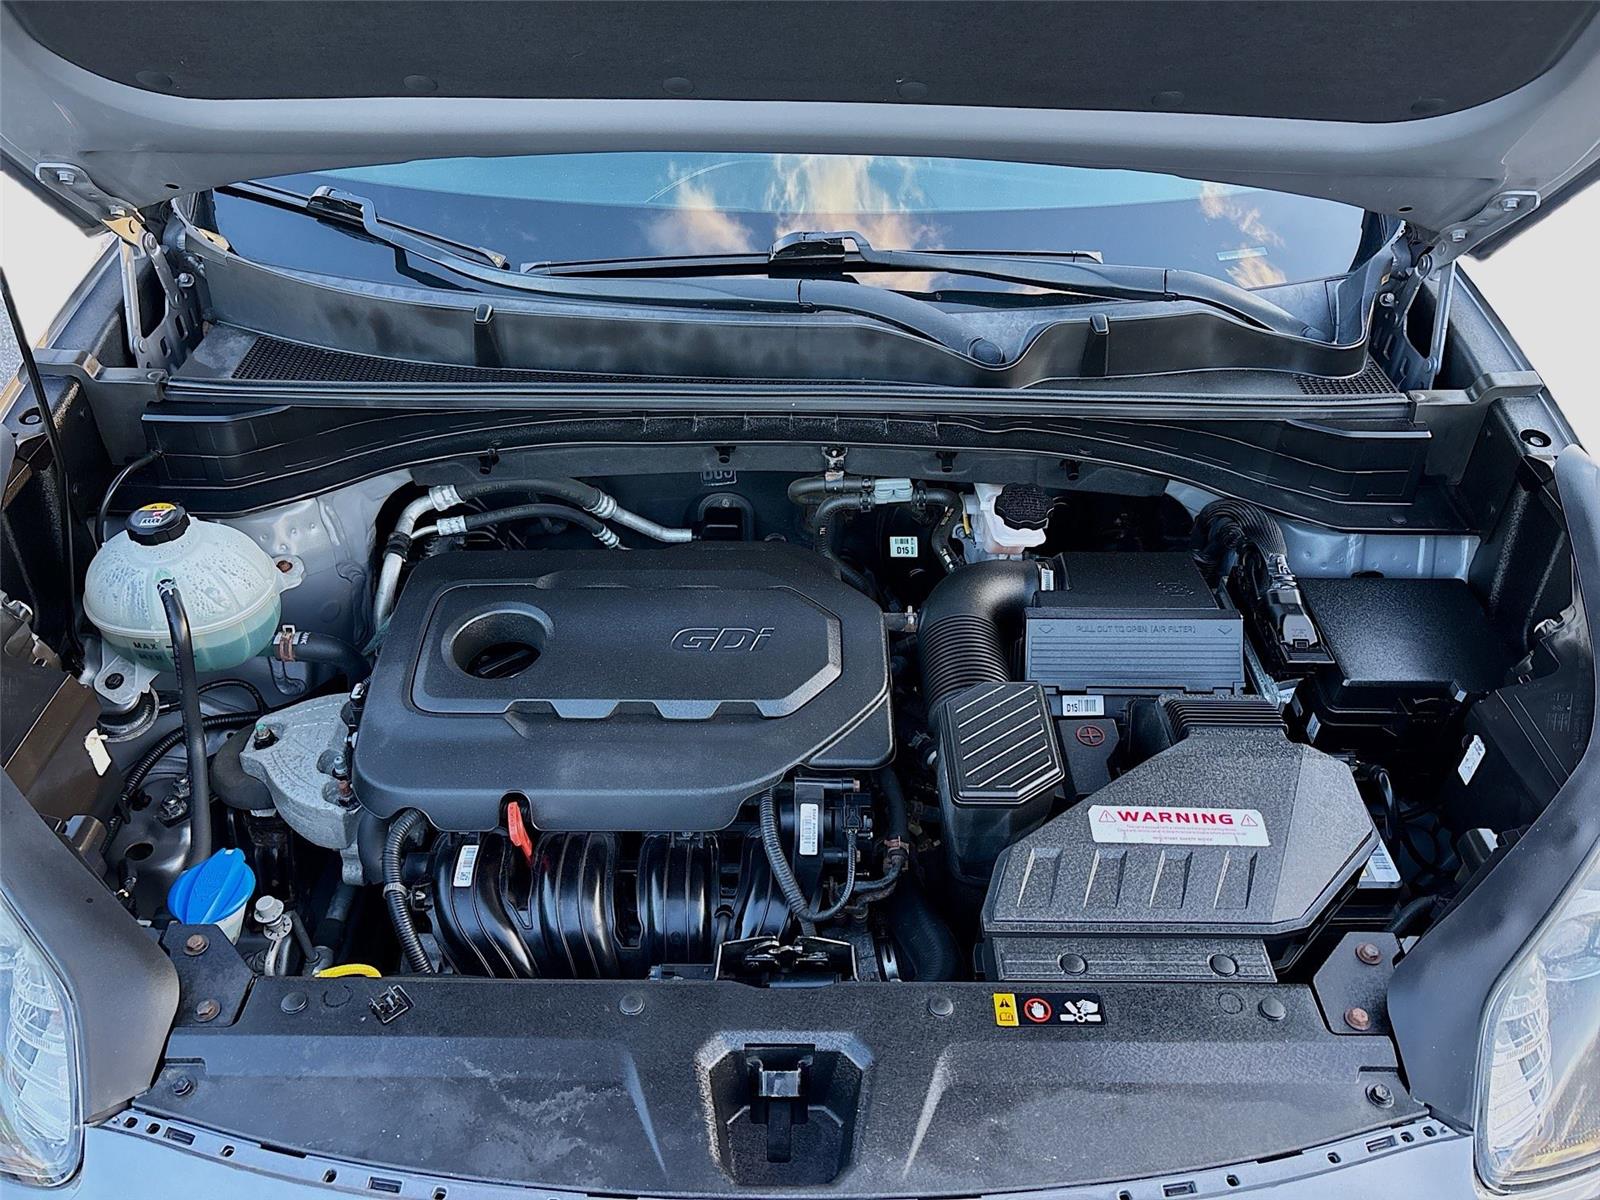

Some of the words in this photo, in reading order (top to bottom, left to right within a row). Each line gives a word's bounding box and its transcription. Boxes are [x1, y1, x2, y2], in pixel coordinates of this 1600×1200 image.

[1076, 625, 1096, 633] PULL
[1097, 625, 1112, 633] OUT
[1114, 625, 1125, 633] TO
[1127, 625, 1147, 633] OPEN
[133, 641, 158, 650] MAX
[1117, 810, 1234, 825] WARNING
